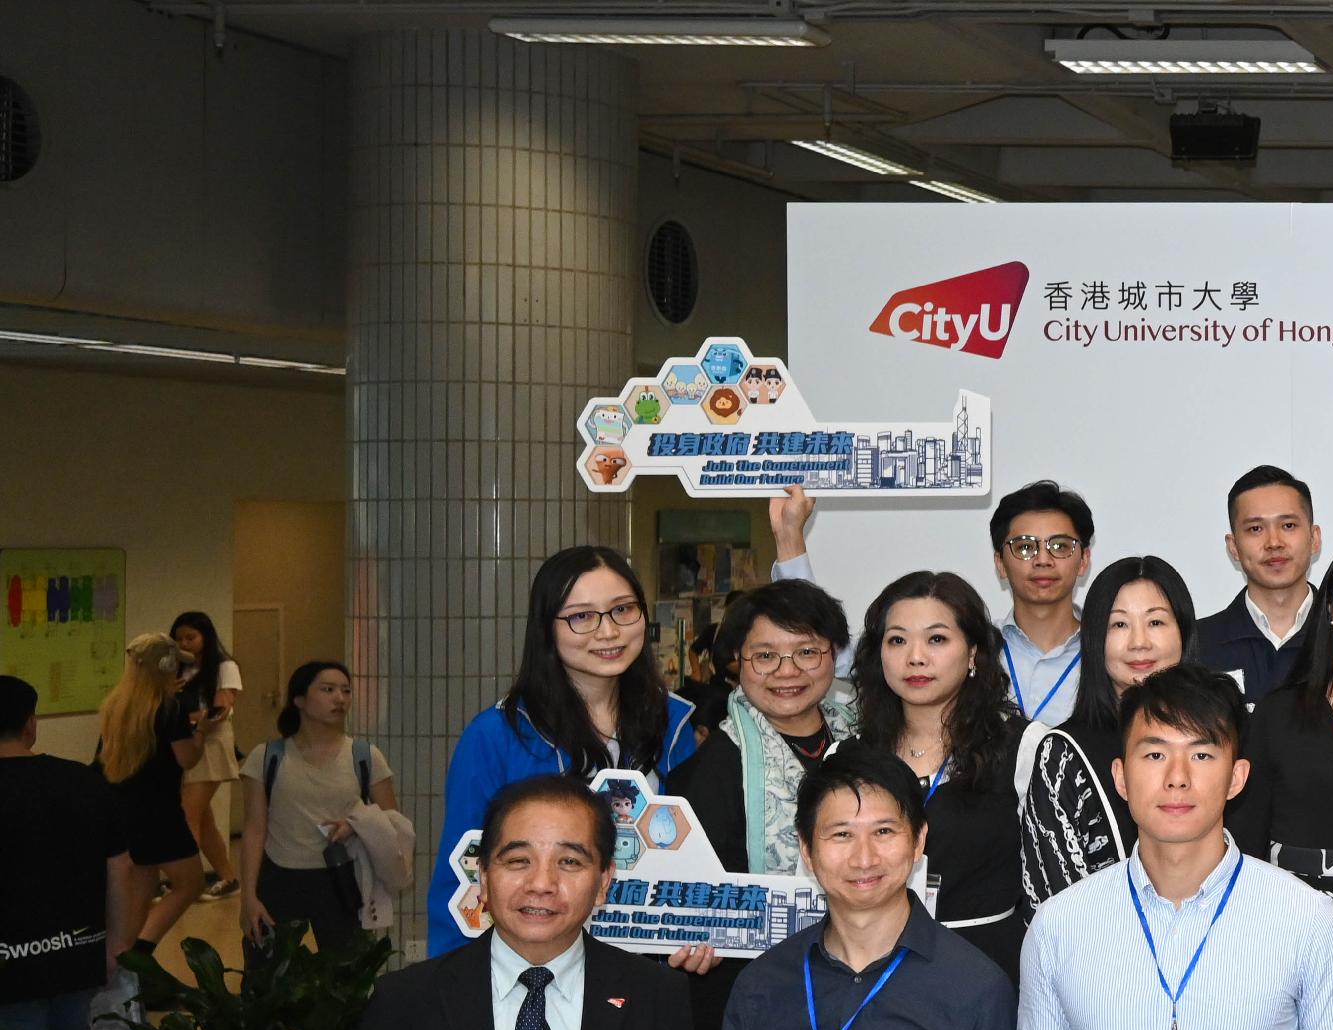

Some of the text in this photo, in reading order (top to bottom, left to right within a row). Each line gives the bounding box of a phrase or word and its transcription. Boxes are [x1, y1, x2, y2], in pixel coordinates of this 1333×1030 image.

[1043, 280, 1260, 312] 香港城市大學
[889, 302, 1011, 351] CityU
[1043, 319, 1098, 347] City
[1104, 318, 1236, 348] University
[1243, 318, 1273, 343] of
[647, 431, 854, 456] 投身政府 共建未來
[702, 459, 849, 473] Join the Government
[700, 474, 804, 487] Build Our Future
[650, 880, 768, 911] 共建未來
[590, 925, 710, 942] Build Our Future
[632, 911, 660, 925] the
[661, 912, 763, 929] Government
[0, 931, 73, 960] Swoosh
